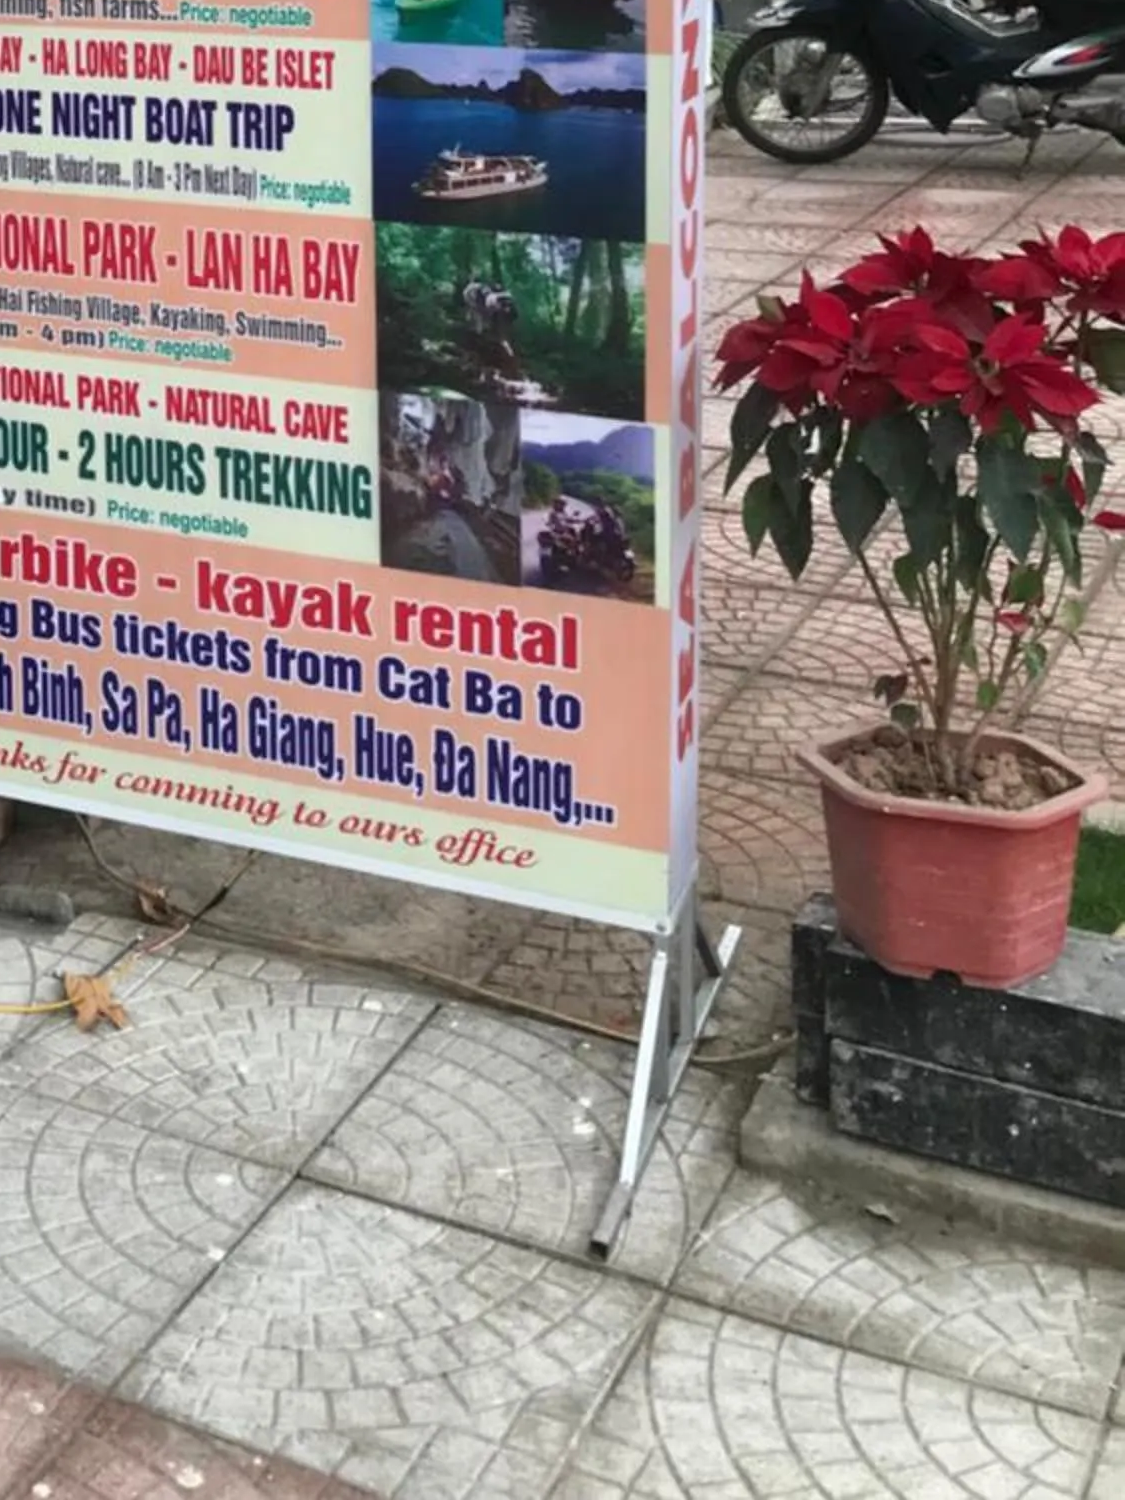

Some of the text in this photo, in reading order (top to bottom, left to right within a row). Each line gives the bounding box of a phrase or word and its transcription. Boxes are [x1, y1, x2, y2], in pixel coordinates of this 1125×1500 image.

[52, 91, 136, 142] NIGHT
[144, 96, 217, 147] BOAT
[225, 101, 295, 151] TRIP
[83, 220, 157, 283] PARK
[186, 228, 244, 292] LAN
[253, 235, 293, 298] HA
[303, 241, 360, 304] BAY
[27, 289, 83, 322] Fishing
[85, 295, 147, 328] Village,
[150, 301, 232, 338] Kayaking,
[61, 329, 106, 350] pm)
[77, 377, 141, 418] PARK
[165, 386, 277, 436] NATURAL
[283, 400, 350, 444] CAVE
[25, 489, 249, 539] time) Price: negotiable
[78, 429, 97, 480] 2
[105, 434, 207, 497] HOURS
[215, 446, 373, 519] TREKKING
[196, 560, 373, 636] kayak
[394, 597, 579, 670] rental
[31, 599, 103, 648] Bus
[113, 612, 253, 674] tickets
[264, 637, 363, 693] from
[377, 656, 451, 710] Cat
[464, 670, 524, 721] Ba
[537, 684, 583, 731] to
[22, 656, 93, 735] Binh,
[101, 670, 139, 738] Sa
[146, 678, 192, 754] Pa,
[200, 687, 238, 754] Ha
[248, 695, 346, 782] Giang,
[354, 713, 425, 798] Hue,
[433, 728, 477, 800] Đa
[486, 737, 616, 828] Nang,...
[43, 750, 108, 785] for
[115, 770, 287, 828] comming
[291, 803, 333, 830] to
[339, 813, 427, 849] ours
[434, 826, 541, 871] office
